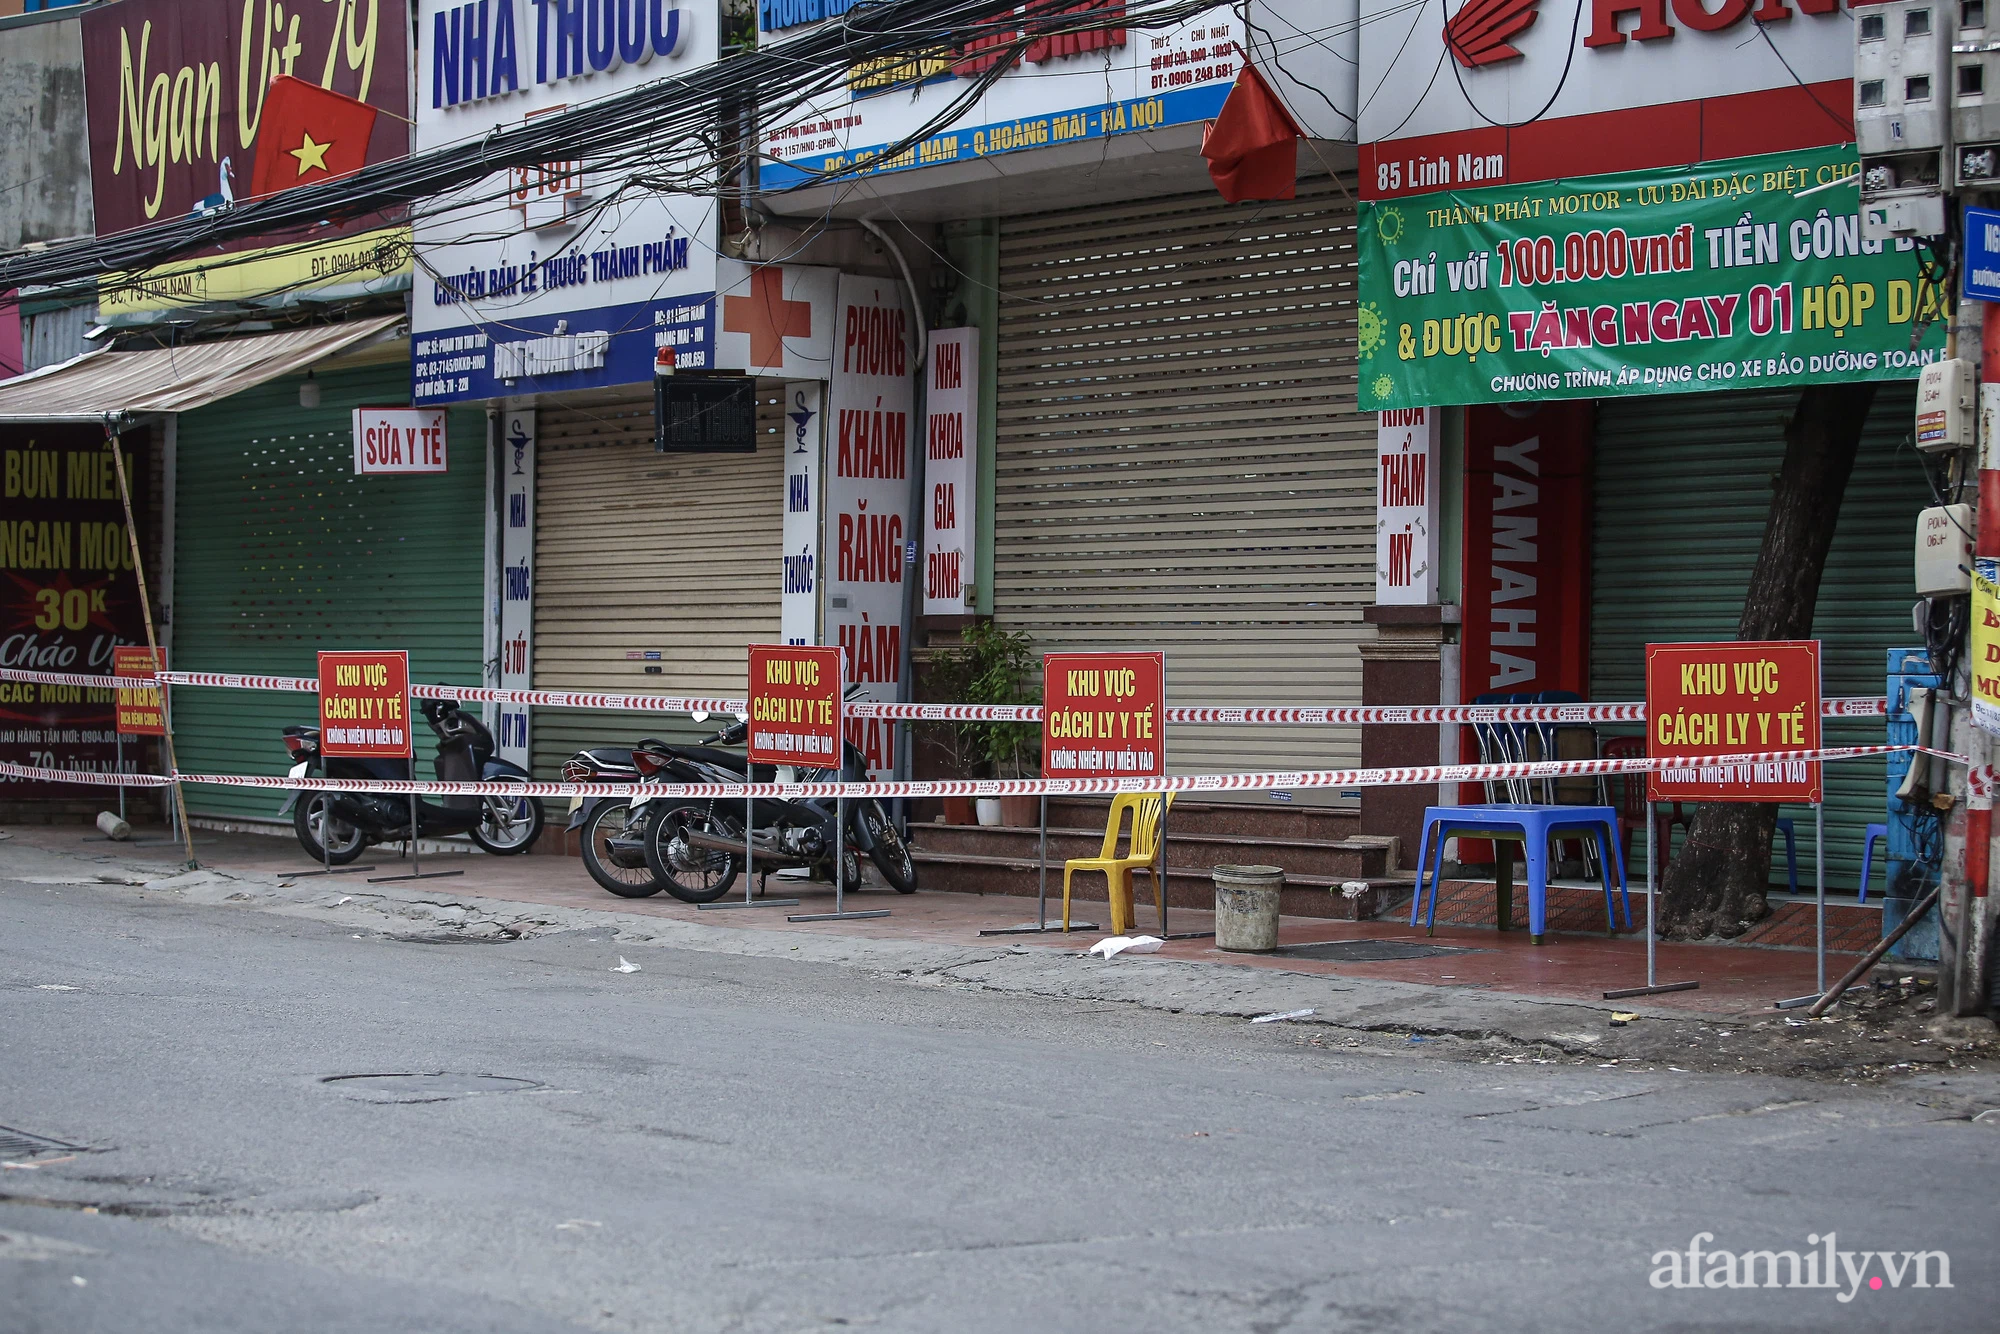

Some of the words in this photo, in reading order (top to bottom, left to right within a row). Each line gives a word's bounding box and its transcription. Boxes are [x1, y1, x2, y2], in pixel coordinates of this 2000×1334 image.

[1166, 36, 1170, 47] 2
[1191, 25, 1205, 42] CHỦ
[1210, 23, 1230, 40] NHẬT
[1168, 69, 1192, 86] 0906
[1195, 66, 1213, 82] 248
[1216, 62, 1233, 79] 681
[113, 20, 221, 219] Ngan
[919, 136, 958, 164] NAM
[973, 119, 1048, 157] Q.HOÀNG
[1052, 112, 1086, 141] MAI
[1101, 101, 1126, 133] HÀ
[1131, 97, 1164, 131] NỘI
[1891, 121, 1901, 137] 16
[1377, 165, 1402, 192] 85
[1408, 154, 1452, 188] Lĩnh
[1457, 152, 1504, 182] Nam
[1426, 200, 1489, 229] THÀNH
[1493, 194, 1543, 224] PHÁT
[1547, 188, 1620, 218] MOTOR
[1637, 181, 1666, 207] ƯU
[1670, 176, 1706, 203] ĐÃI
[1711, 170, 1757, 202] ĐẶC
[1762, 164, 1809, 197] BIỆT
[489, 260, 517, 298] BÁN
[521, 250, 537, 293] LẺ
[541, 245, 588, 290] THUỐC
[591, 242, 640, 282] THÀNH
[643, 225, 688, 274] PHẨM
[1393, 248, 1436, 298] Chỉ
[1446, 248, 1488, 292] với
[1704, 210, 1778, 269] TIỀN
[170, 276, 192, 296] NAM
[677, 328, 690, 345] MAI
[694, 326, 704, 343] HN
[843, 290, 906, 378] PHÒNG
[1398, 323, 1416, 359] &
[1422, 312, 1502, 364] ĐƯỢC
[1508, 301, 1616, 352] TẶNG
[1618, 294, 1741, 346] NGAY
[1746, 281, 1794, 335] 01
[1801, 274, 1875, 344] HỘP
[935, 342, 963, 391] NHA
[1491, 368, 1561, 395] CHƯƠNG
[1564, 360, 1612, 390] TRÌNH
[1616, 361, 1636, 387] ÁP
[1642, 361, 1692, 391] DỤNG
[1697, 358, 1736, 382] CHO
[1740, 357, 1761, 380] XE
[1766, 348, 1802, 377] BẢO
[1808, 346, 1878, 375] DƯỠNG
[366, 421, 402, 466] SỮA
[406, 428, 416, 465] Y
[420, 416, 442, 465] TẾ
[837, 395, 906, 480] KHÁM
[928, 412, 964, 461] KHOA
[5, 440, 58, 499] BÚN
[789, 465, 810, 513] NHÀ
[1381, 432, 1426, 508] THẨM
[510, 486, 527, 529] NHÀ
[934, 482, 956, 531] GIA
[0, 520, 71, 569] NGAN
[79, 522, 136, 582] MỌC
[838, 498, 903, 584] RĂNG
[1388, 522, 1414, 588] MỸ
[1489, 436, 1540, 690] YAMAHA
[505, 556, 530, 602] THUỐC
[784, 544, 814, 595] THUỐC
[928, 544, 961, 600] ĐÌNH
[0, 633, 77, 669] Cháo
[504, 640, 510, 675] 3
[512, 630, 527, 675] TỐT
[839, 611, 901, 684] HÀM
[336, 664, 360, 686] KHU
[363, 662, 388, 692] VỰC
[766, 660, 792, 685] KHU
[794, 658, 820, 691] VỰC
[1068, 670, 1100, 697] KHU
[1104, 667, 1136, 702] VỰC
[1681, 663, 1727, 696] KHU
[1733, 658, 1778, 702] VỰC
[324, 693, 357, 719] CÁCH
[360, 698, 373, 720] LY
[376, 698, 384, 720] Y
[387, 691, 402, 720] TẾ
[501, 713, 512, 748] UY
[514, 706, 527, 748] TÍN
[754, 692, 786, 722] CÁCH
[790, 698, 804, 723] LY
[806, 699, 815, 724] Y
[818, 692, 834, 725] TẾ
[1050, 706, 1093, 738] CÁCH
[1098, 711, 1115, 739] LY
[1120, 712, 1130, 739] Y
[1134, 702, 1154, 739] TẾ
[1658, 706, 1719, 746] CÁCH
[1726, 712, 1750, 745] LY
[1756, 712, 1771, 745] Y
[1778, 701, 1806, 745] TẾ
[17, 728, 41, 744] HÀNG
[43, 728, 60, 746] TẬN
[1051, 746, 1076, 769] KHÔNG
[1078, 746, 1103, 774] NHIỆM
[1105, 750, 1115, 774] VỤ
[1116, 744, 1137, 771] MIỄN
[1138, 746, 1154, 772] VÀO
